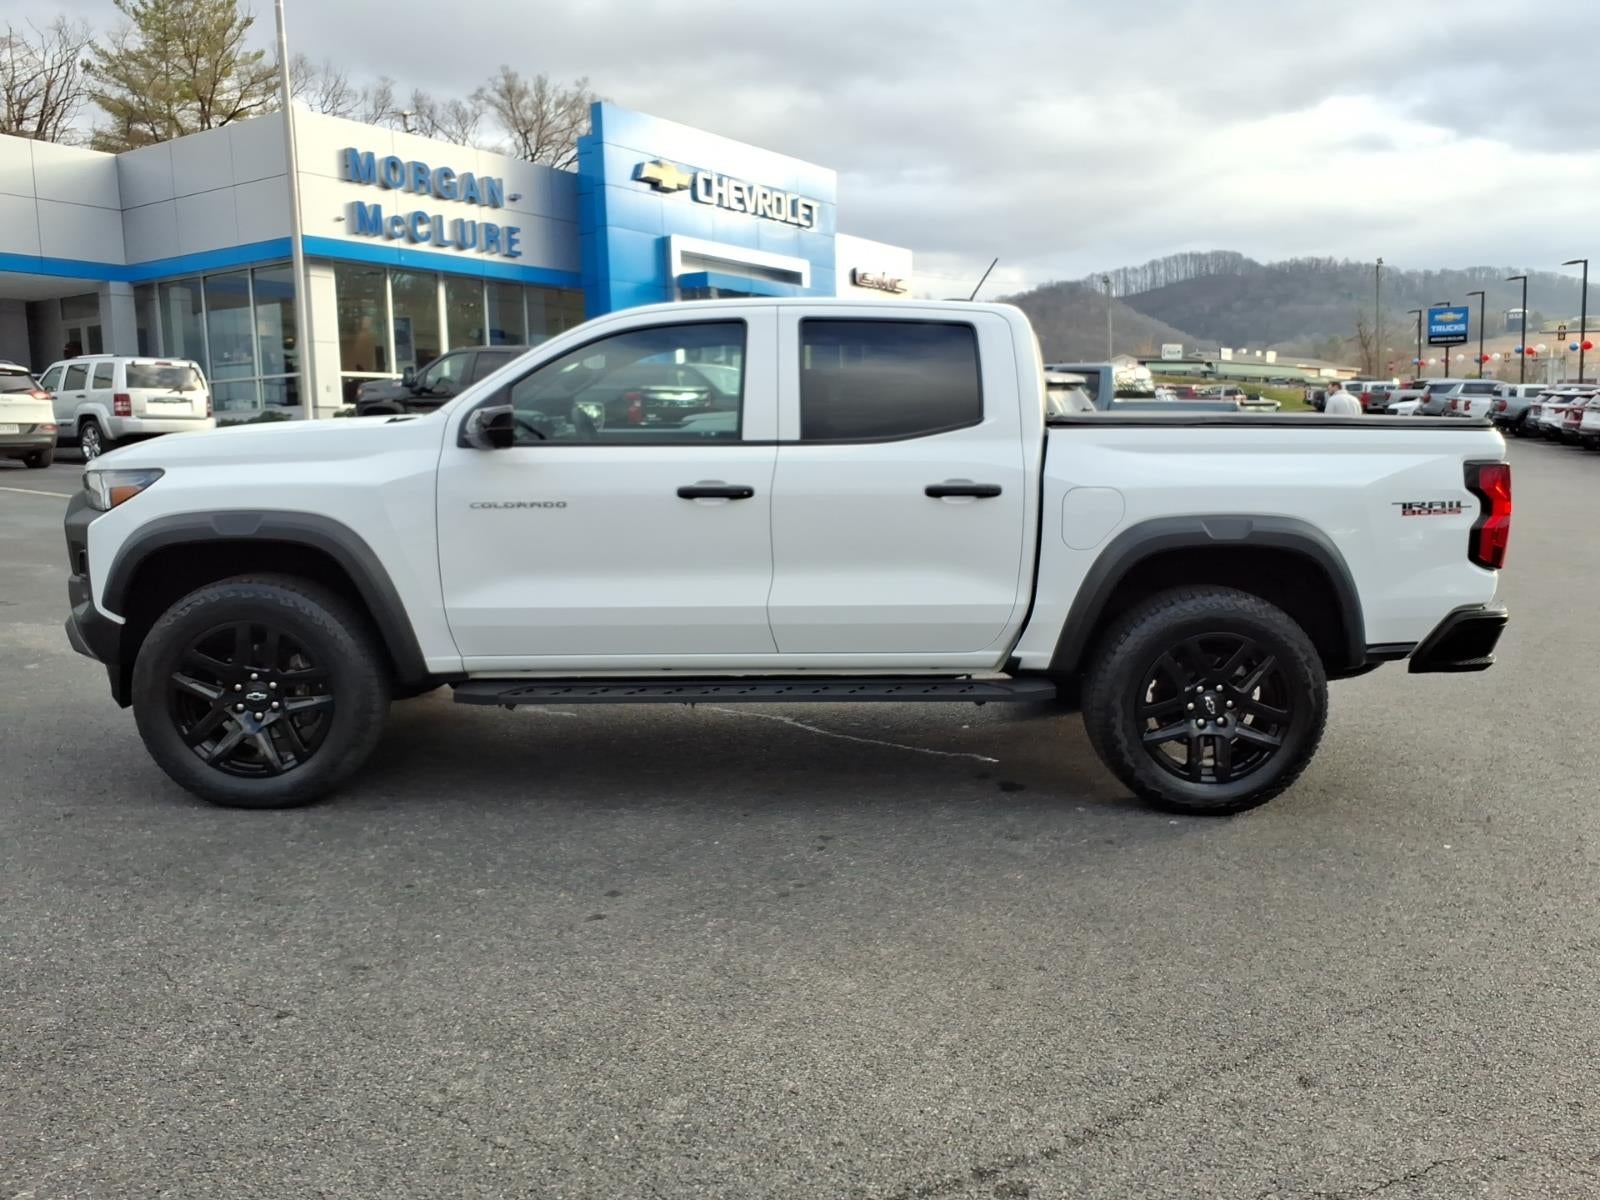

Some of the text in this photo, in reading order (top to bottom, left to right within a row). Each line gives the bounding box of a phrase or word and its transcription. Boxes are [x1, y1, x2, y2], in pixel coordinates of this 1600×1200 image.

[691, 171, 820, 231] CHEVROLET
[345, 200, 522, 257] McCLURE
[1431, 324, 1466, 332] TRUCKS
[469, 501, 567, 509] COLORADO
